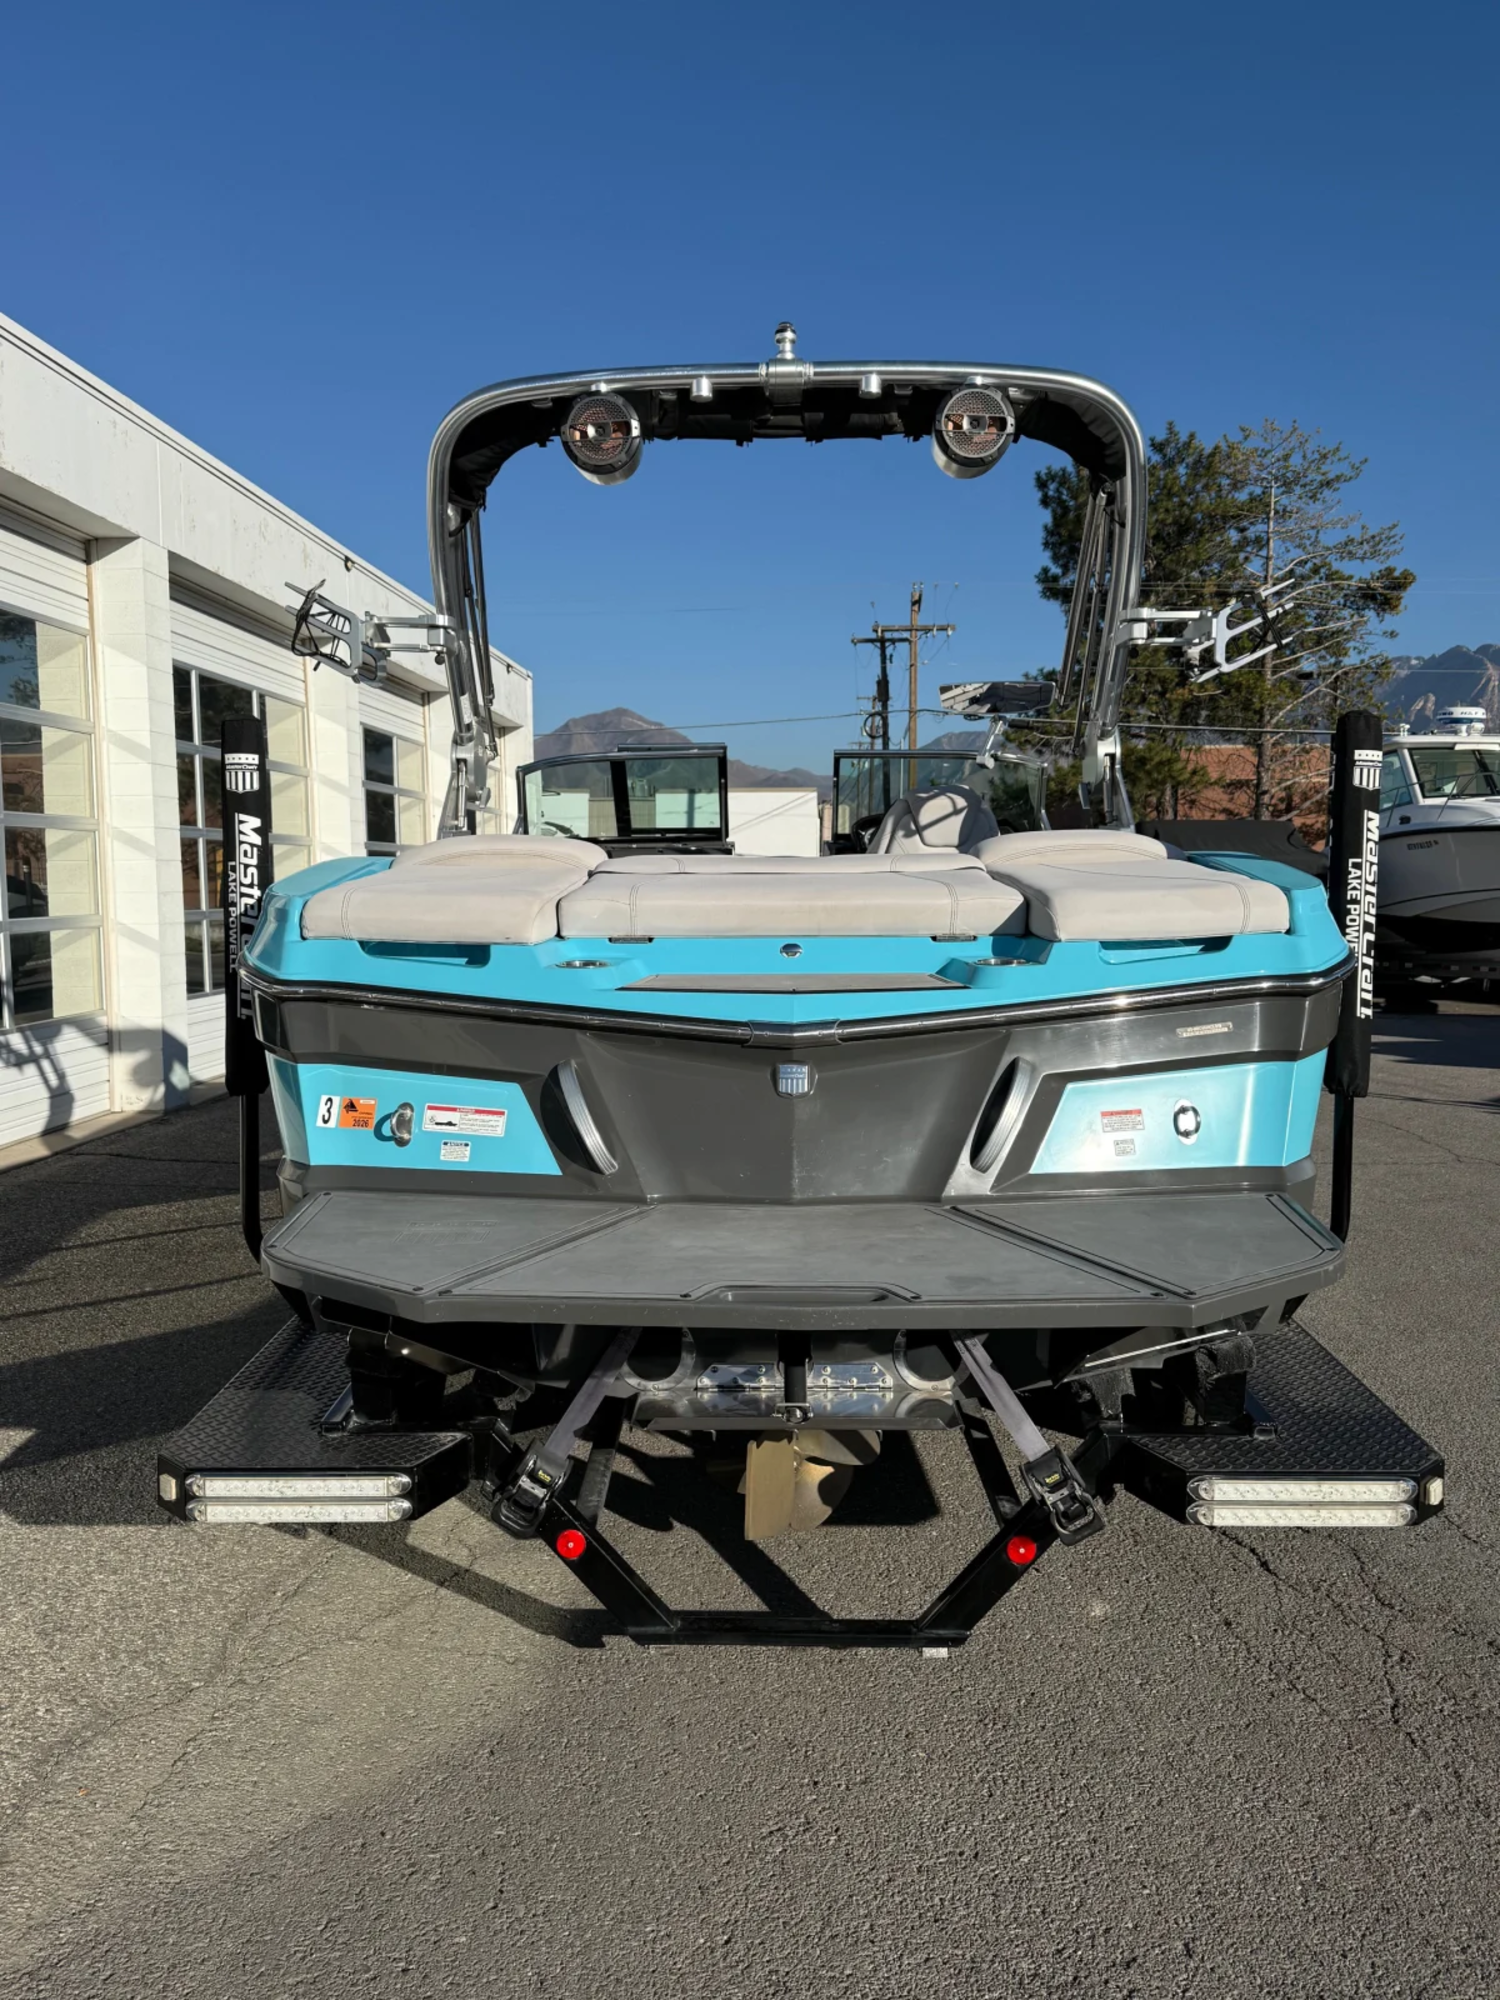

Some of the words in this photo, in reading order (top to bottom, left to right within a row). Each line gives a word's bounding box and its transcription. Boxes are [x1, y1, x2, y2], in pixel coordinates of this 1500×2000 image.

[228, 861, 237, 903] LAKE
[1347, 858, 1361, 900] LAKE
[228, 907, 238, 973] POWELL
[322, 1097, 333, 1125] 3
[352, 1118, 369, 1128] 2026
